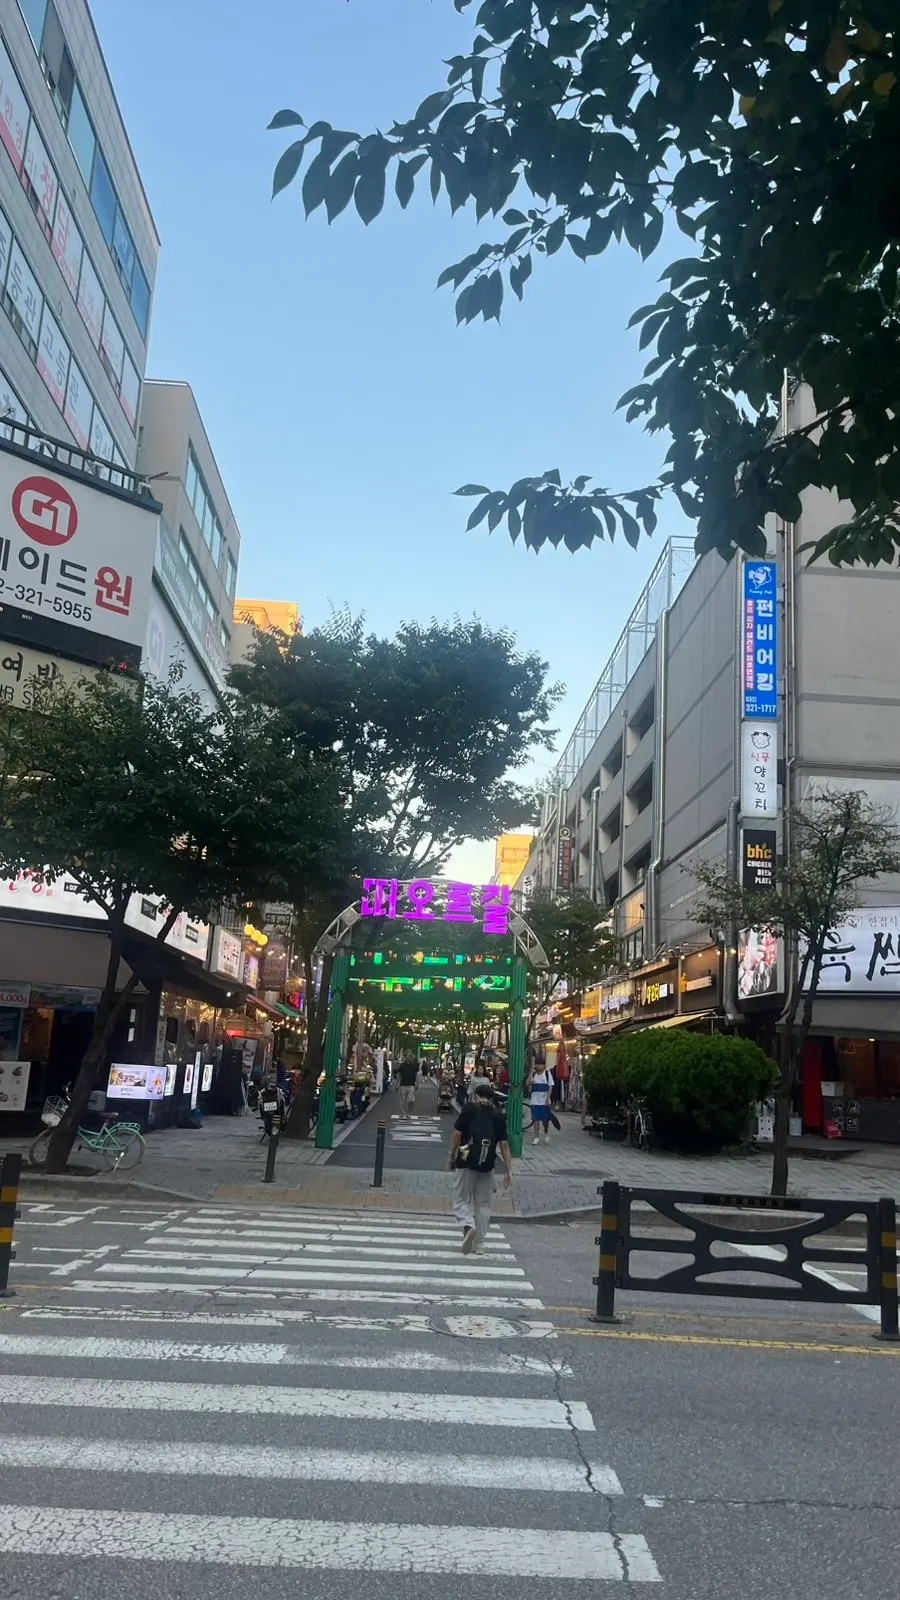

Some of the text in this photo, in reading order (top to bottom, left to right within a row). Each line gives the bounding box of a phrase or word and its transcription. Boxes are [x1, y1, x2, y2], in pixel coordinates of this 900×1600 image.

[756, 599, 773, 691] 펀비어킹
[745, 703, 776, 713] 321-1717
[747, 843, 772, 859] bhc
[747, 860, 772, 868] CHICKEN
[755, 877, 772, 885] PLATE
